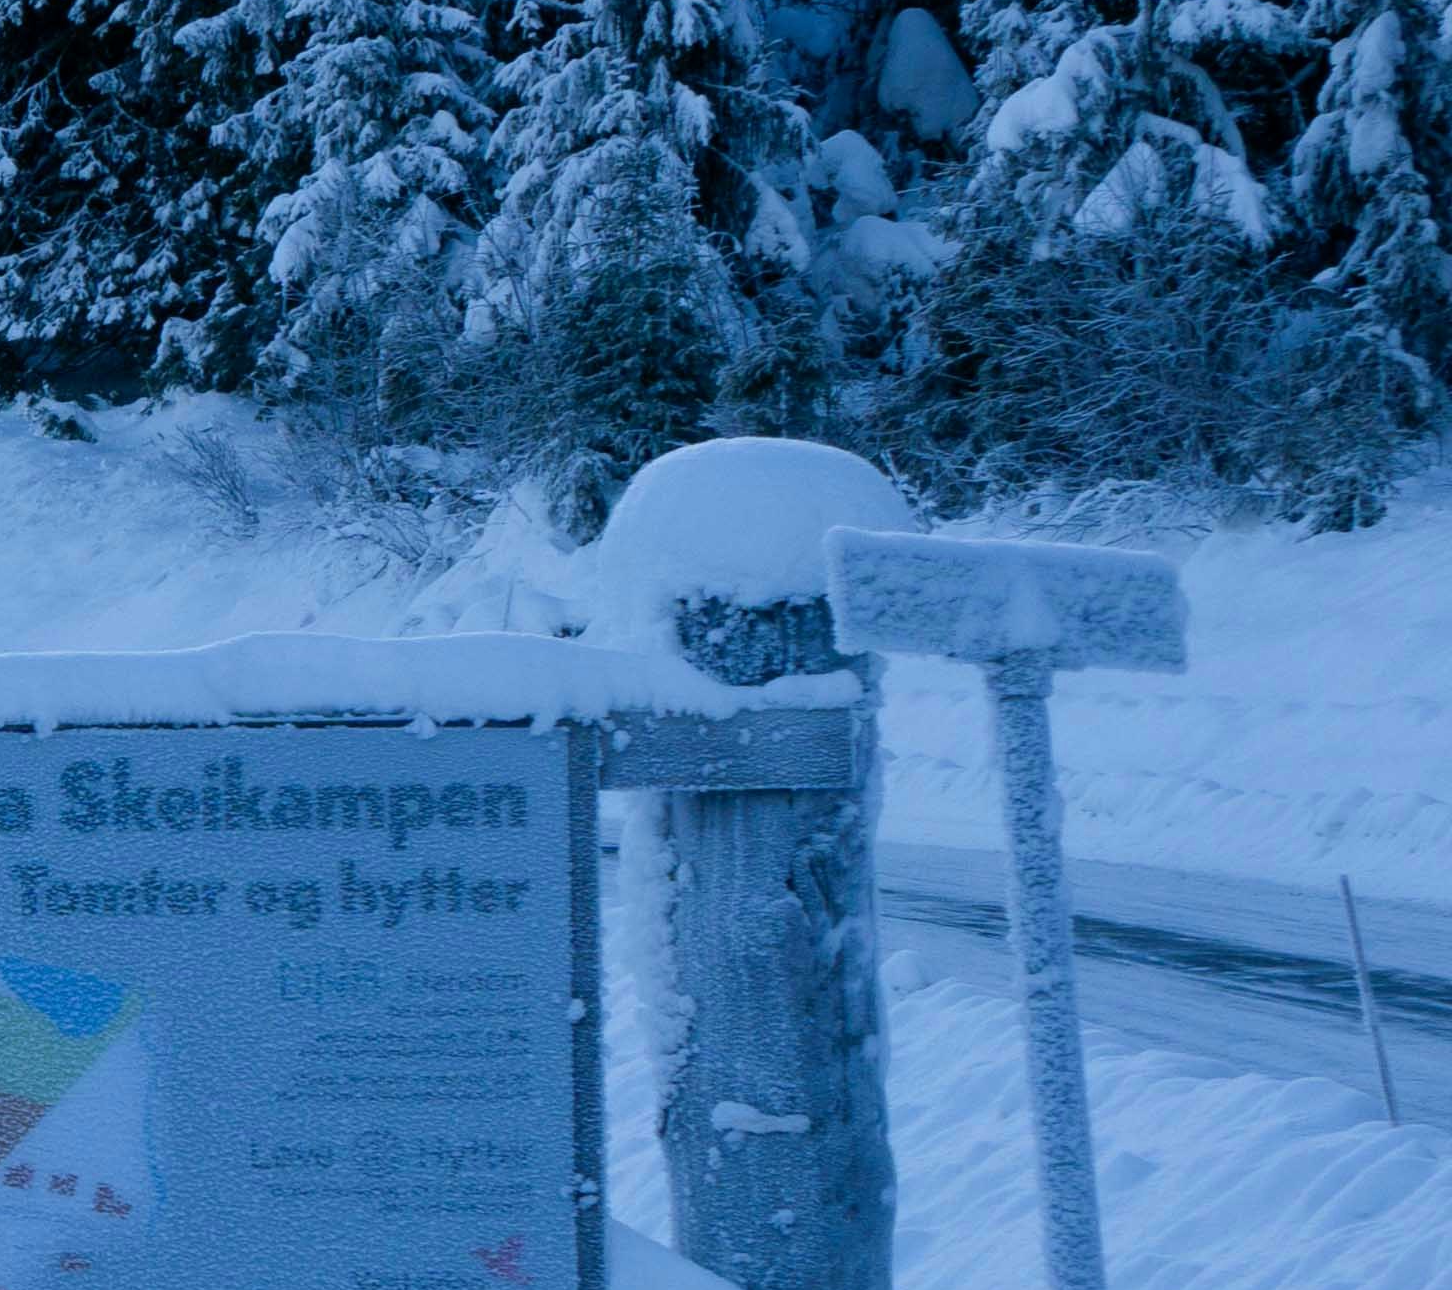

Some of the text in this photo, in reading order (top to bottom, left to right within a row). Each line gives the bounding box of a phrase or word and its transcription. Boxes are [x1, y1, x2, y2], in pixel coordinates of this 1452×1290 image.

[59, 755, 528, 851] Skeikampen
[12, 859, 531, 929] Tomter og hytter
